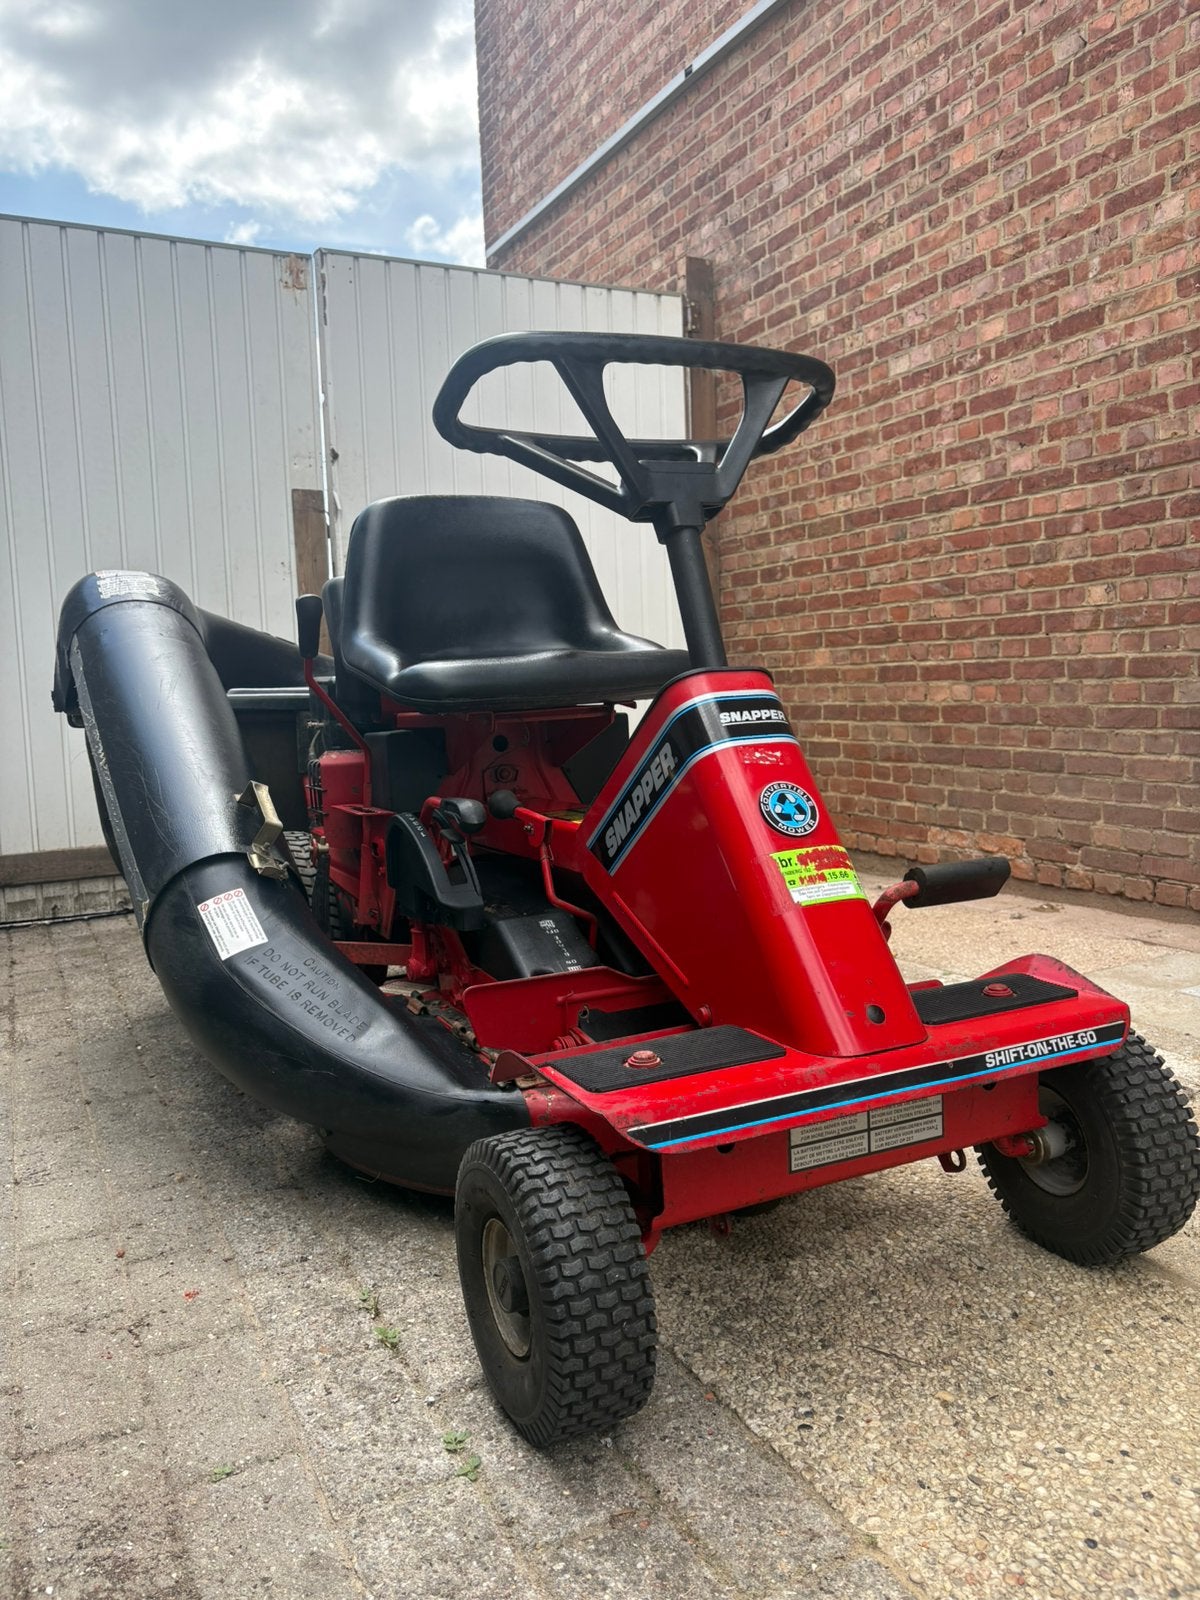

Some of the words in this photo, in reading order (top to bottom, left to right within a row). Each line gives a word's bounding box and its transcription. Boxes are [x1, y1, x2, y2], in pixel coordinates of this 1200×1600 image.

[719, 708, 786, 723] SNAPPER
[605, 742, 676, 858] SNAPPER
[762, 783, 814, 811] CONVERTIBLE
[777, 819, 816, 833] MOWER
[263, 947, 281, 962] DO
[280, 961, 305, 981] NOT
[303, 981, 329, 1001] RUN
[328, 1000, 371, 1031] BLADE
[303, 957, 341, 990] CAUTION
[244, 955, 259, 968] IF
[258, 963, 289, 991] TUBE
[286, 988, 301, 1001] IS
[300, 1000, 357, 1042] REMOVED
[985, 1030, 1097, 1068] SHIFT-ON-THE-GO
